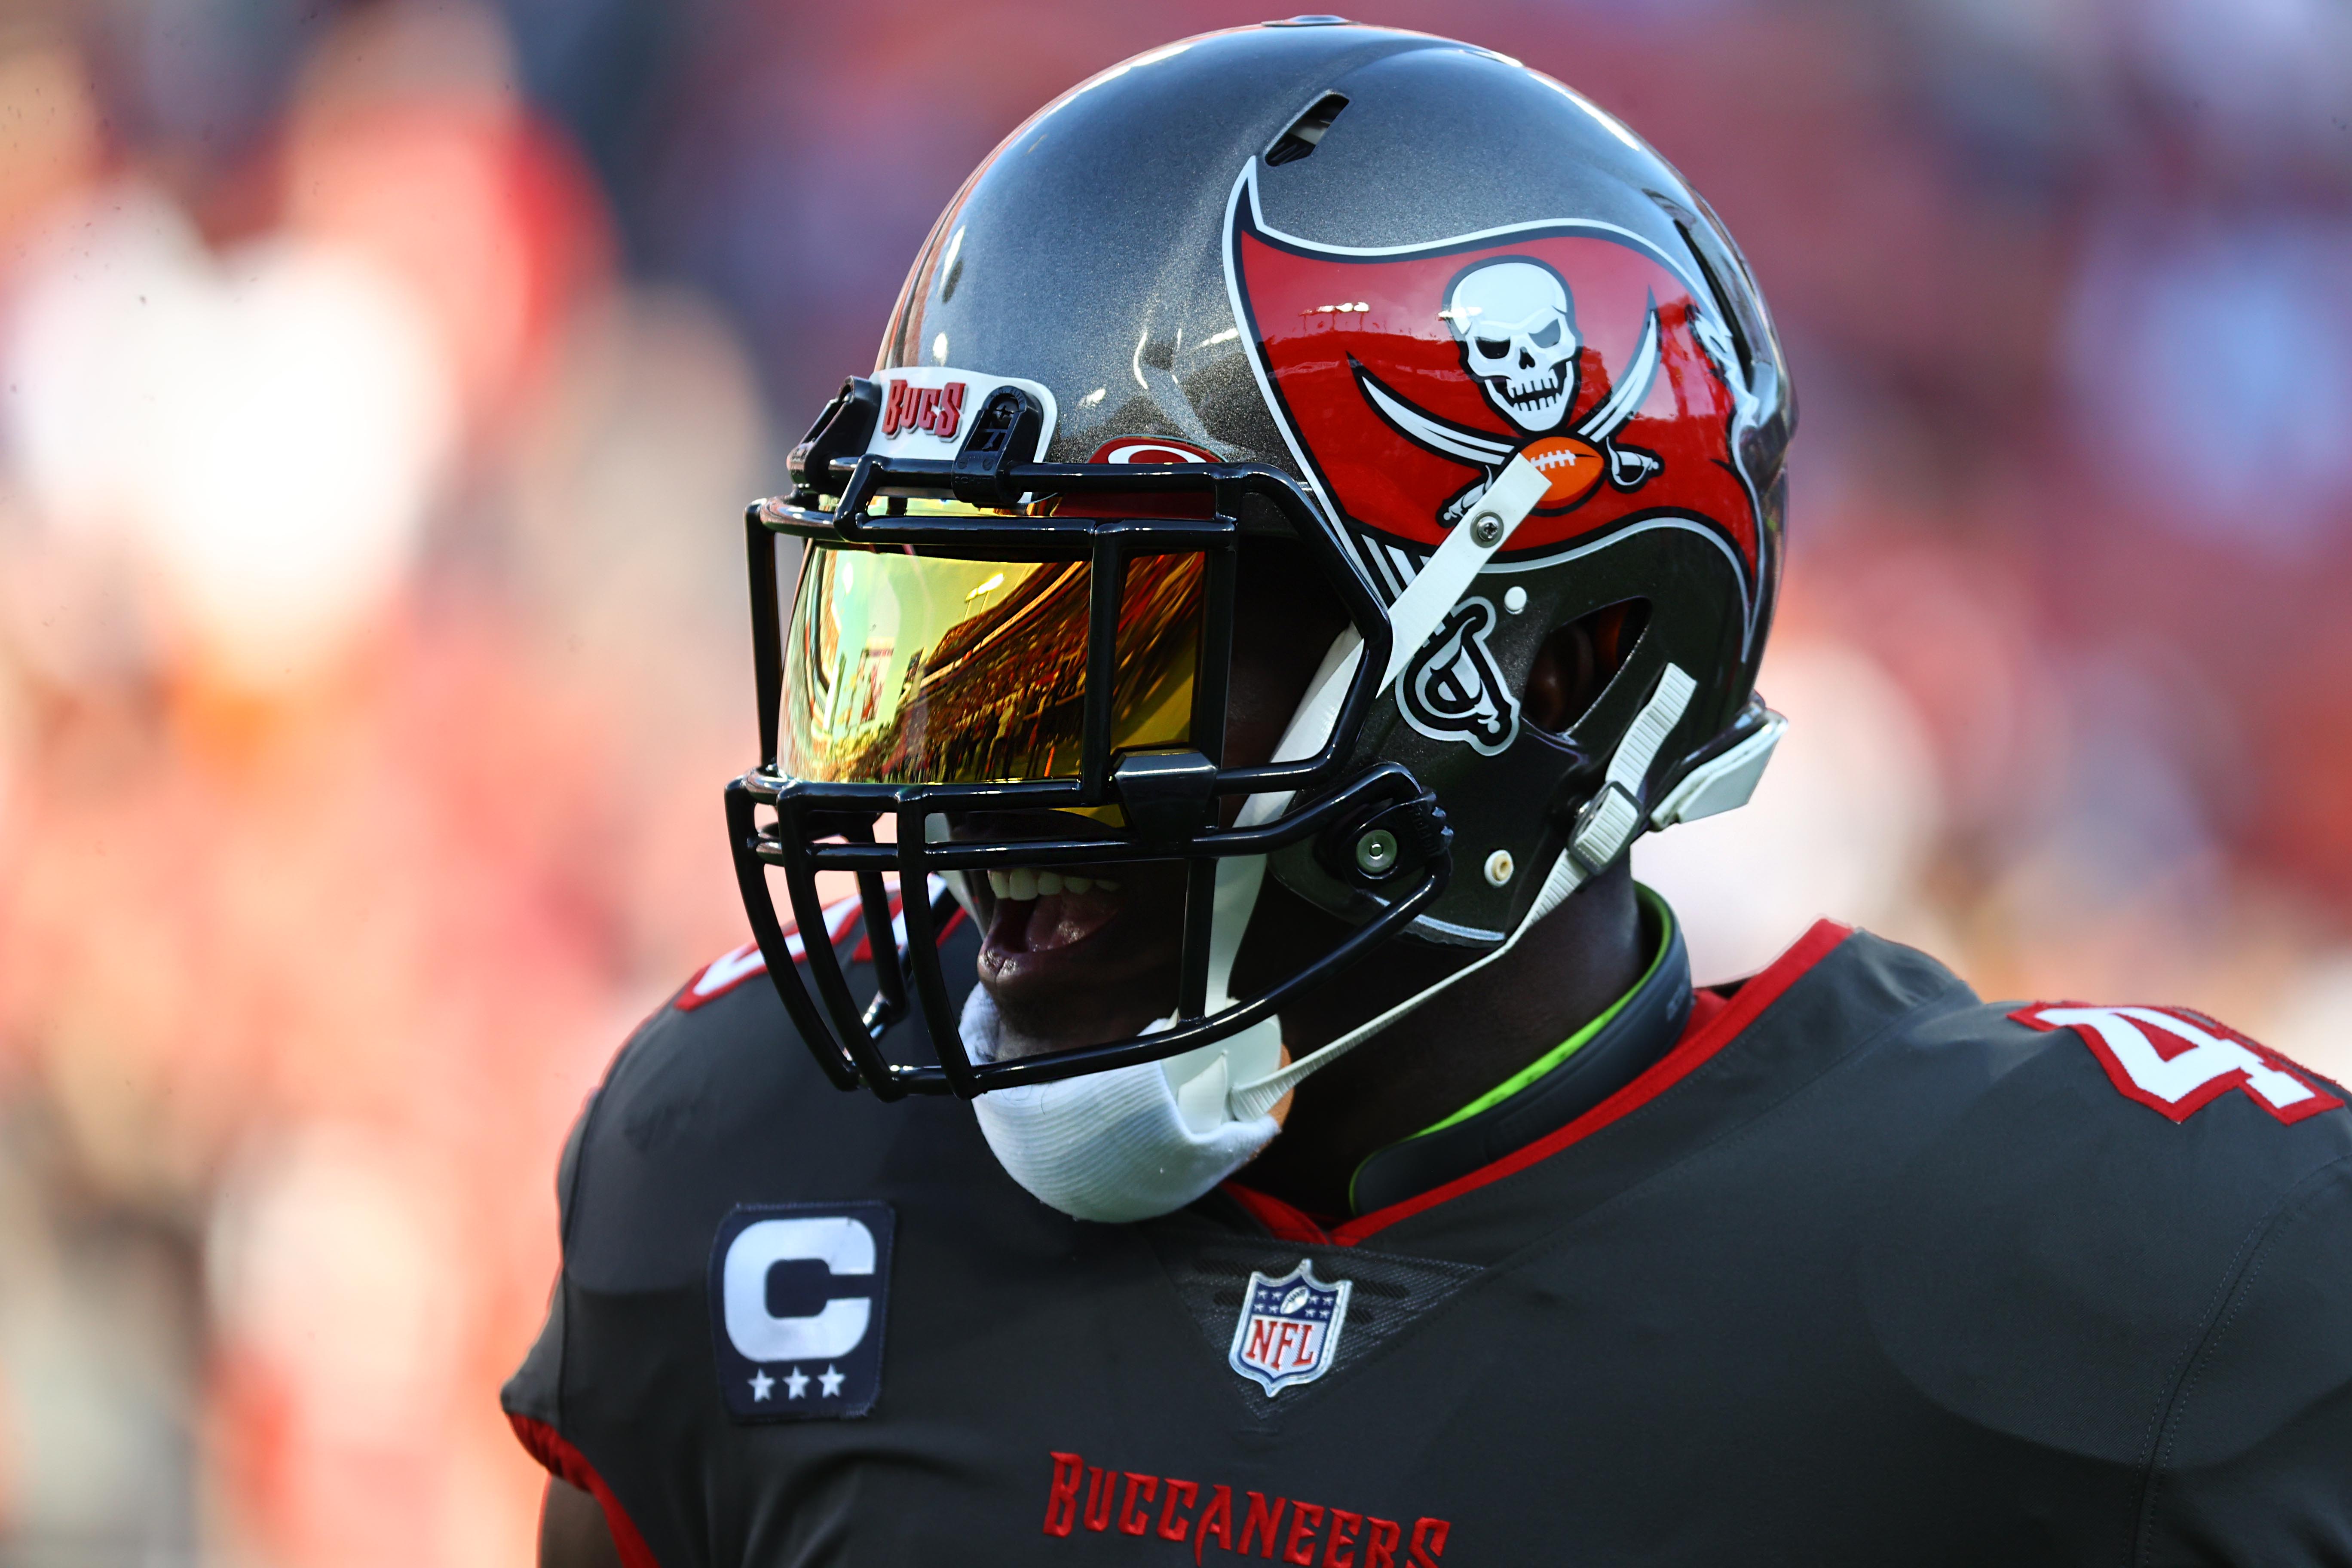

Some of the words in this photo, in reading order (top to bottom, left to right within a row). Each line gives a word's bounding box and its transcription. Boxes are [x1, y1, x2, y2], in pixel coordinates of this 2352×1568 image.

[882, 380, 967, 440] BUCS
[723, 1216, 877, 1363] C
[1246, 1319, 1314, 1371] NFL
[1043, 1451, 1451, 1568] BUCCANEERS
